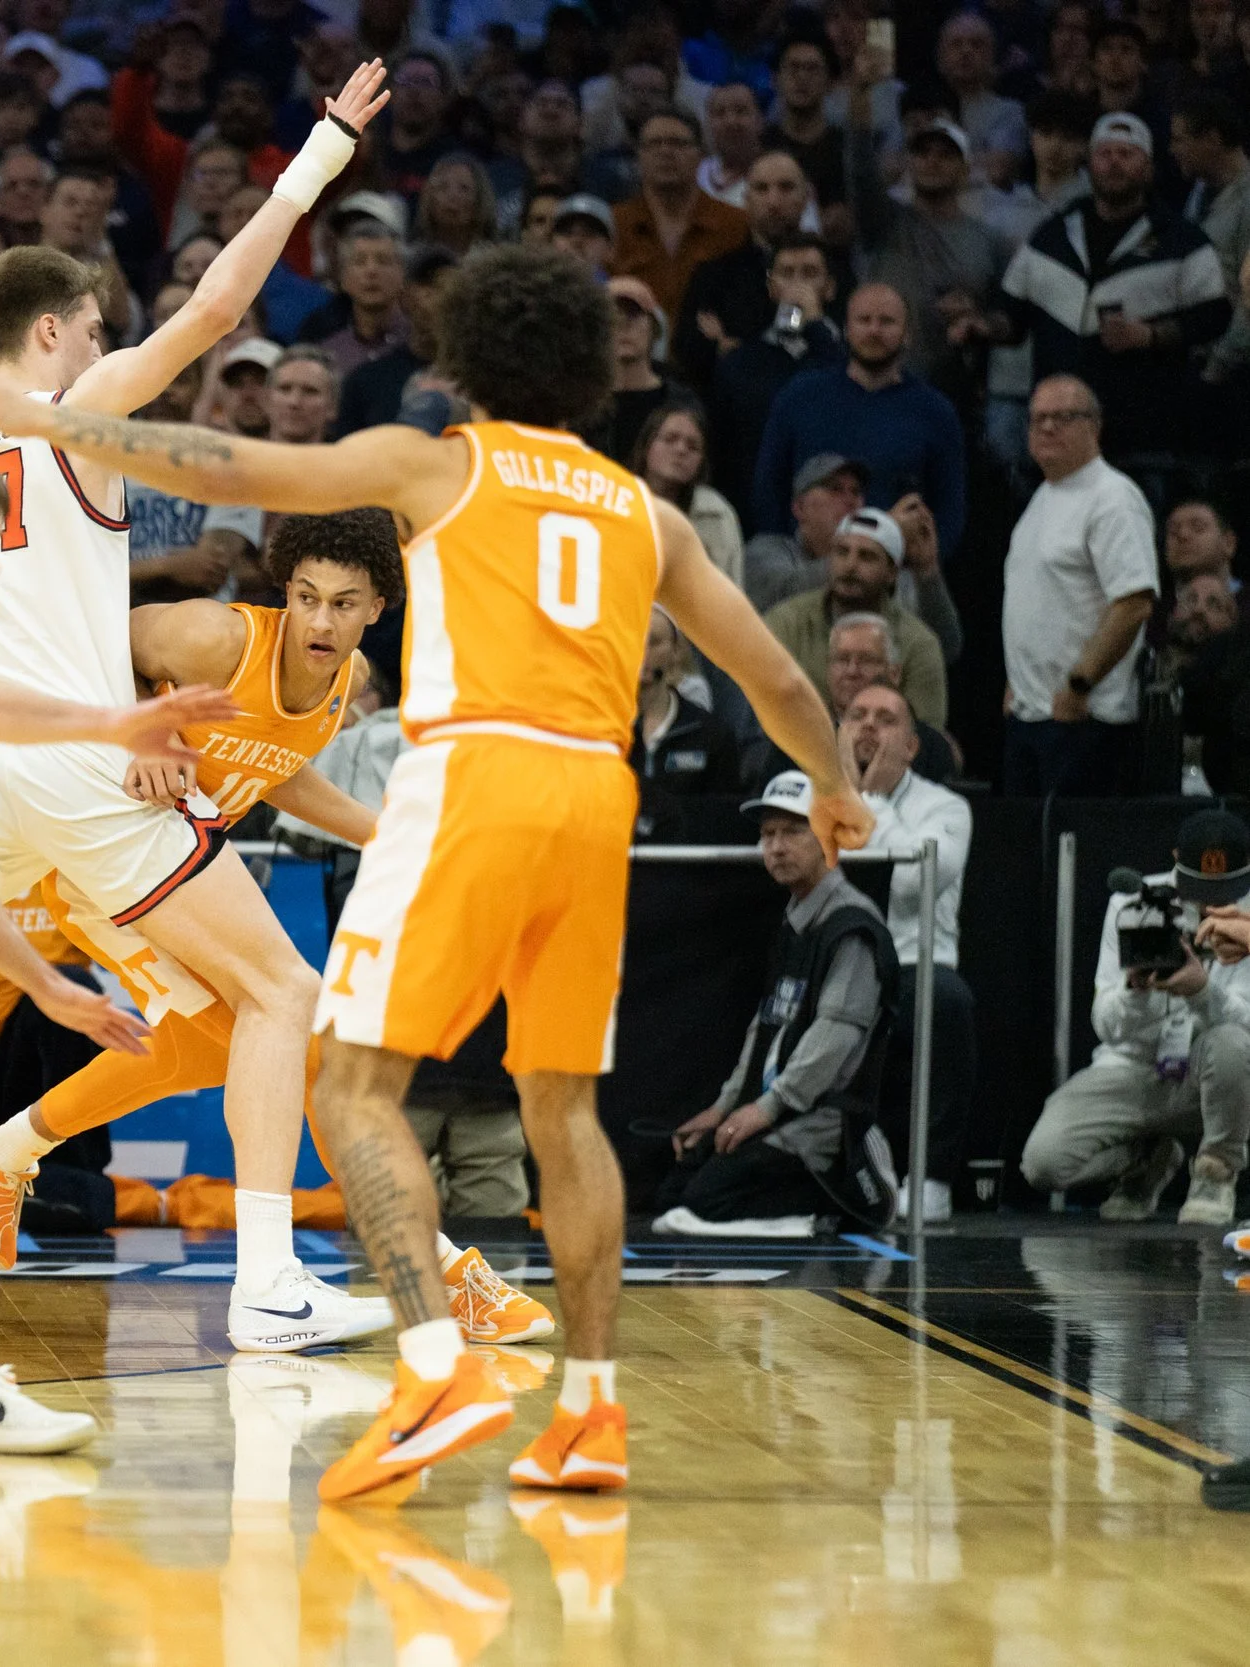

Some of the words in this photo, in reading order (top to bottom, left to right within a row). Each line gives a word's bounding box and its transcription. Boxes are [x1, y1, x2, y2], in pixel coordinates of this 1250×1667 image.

[490, 449, 636, 519] GILLESPIE
[538, 511, 600, 631] 0
[197, 732, 309, 778] TENNESSE
[209, 771, 269, 816] 10
[121, 946, 170, 996] T
[332, 930, 382, 997] T
